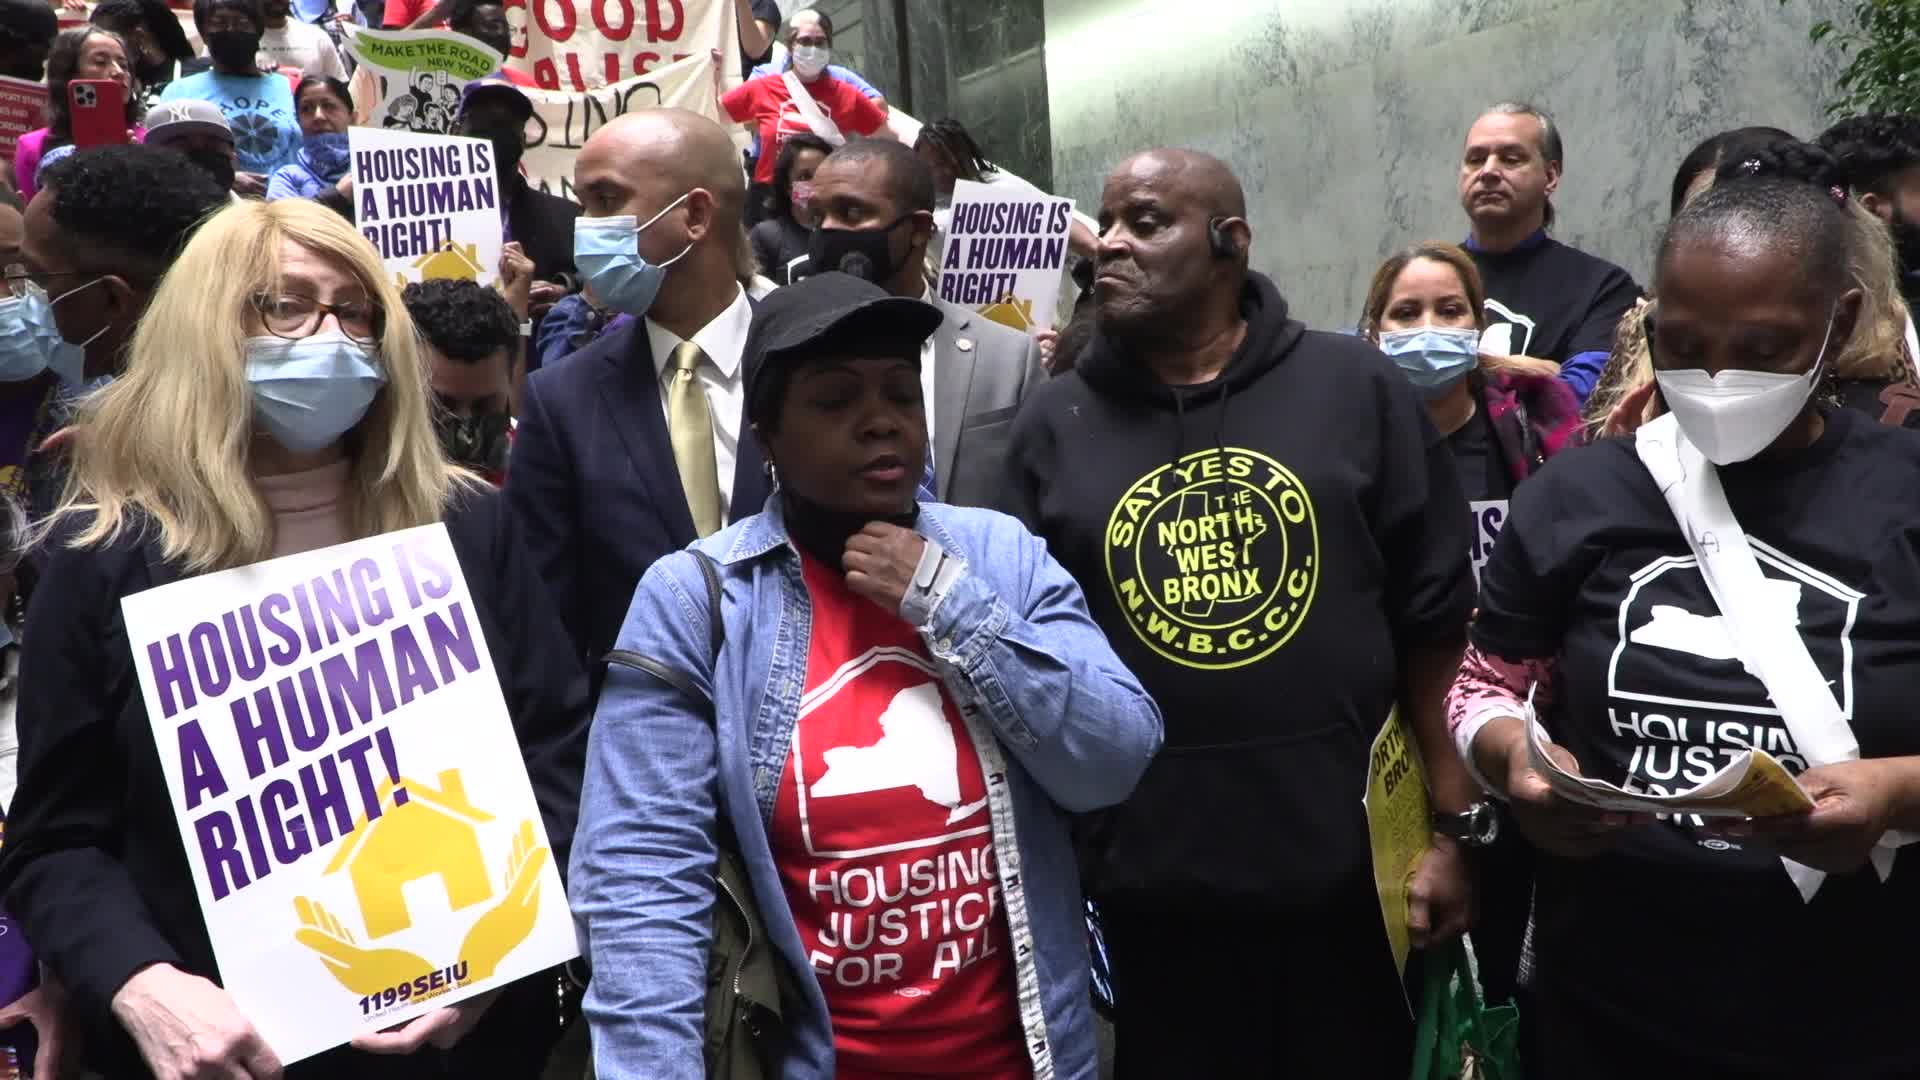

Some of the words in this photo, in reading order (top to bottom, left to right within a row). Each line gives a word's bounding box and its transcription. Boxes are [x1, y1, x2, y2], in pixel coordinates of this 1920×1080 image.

[371, 43, 415, 57] MAKE
[416, 43, 445, 56] THE
[450, 45, 491, 71] ROAD
[427, 57, 455, 68] NEW
[458, 61, 484, 77] YOR
[356, 144, 462, 184] HOUSING
[466, 143, 491, 175] IS
[361, 188, 380, 222] A
[386, 176, 495, 219] HUMAN
[950, 202, 1045, 235] HOUSING
[1045, 202, 1071, 234] IS
[944, 238, 961, 270] A
[966, 237, 1065, 270] HUMAN
[940, 272, 1018, 305] RIGHT!
[1112, 476, 1162, 548] SAY
[1175, 456, 1254, 483] YES
[1264, 467, 1306, 524] TO
[1215, 489, 1252, 509] THE
[1157, 507, 1254, 547] NORTH
[1163, 567, 1263, 605] BRONX
[146, 557, 395, 719] HOUSING
[392, 541, 455, 610] IS
[176, 718, 229, 811] A
[229, 600, 482, 780] HUMAN
[1607, 708, 1799, 754] HOUSIN
[193, 726, 410, 902] RIGHT!
[809, 950, 904, 987] FOR
[931, 927, 998, 980] ALL
[358, 960, 469, 1015] 1199SEIU
